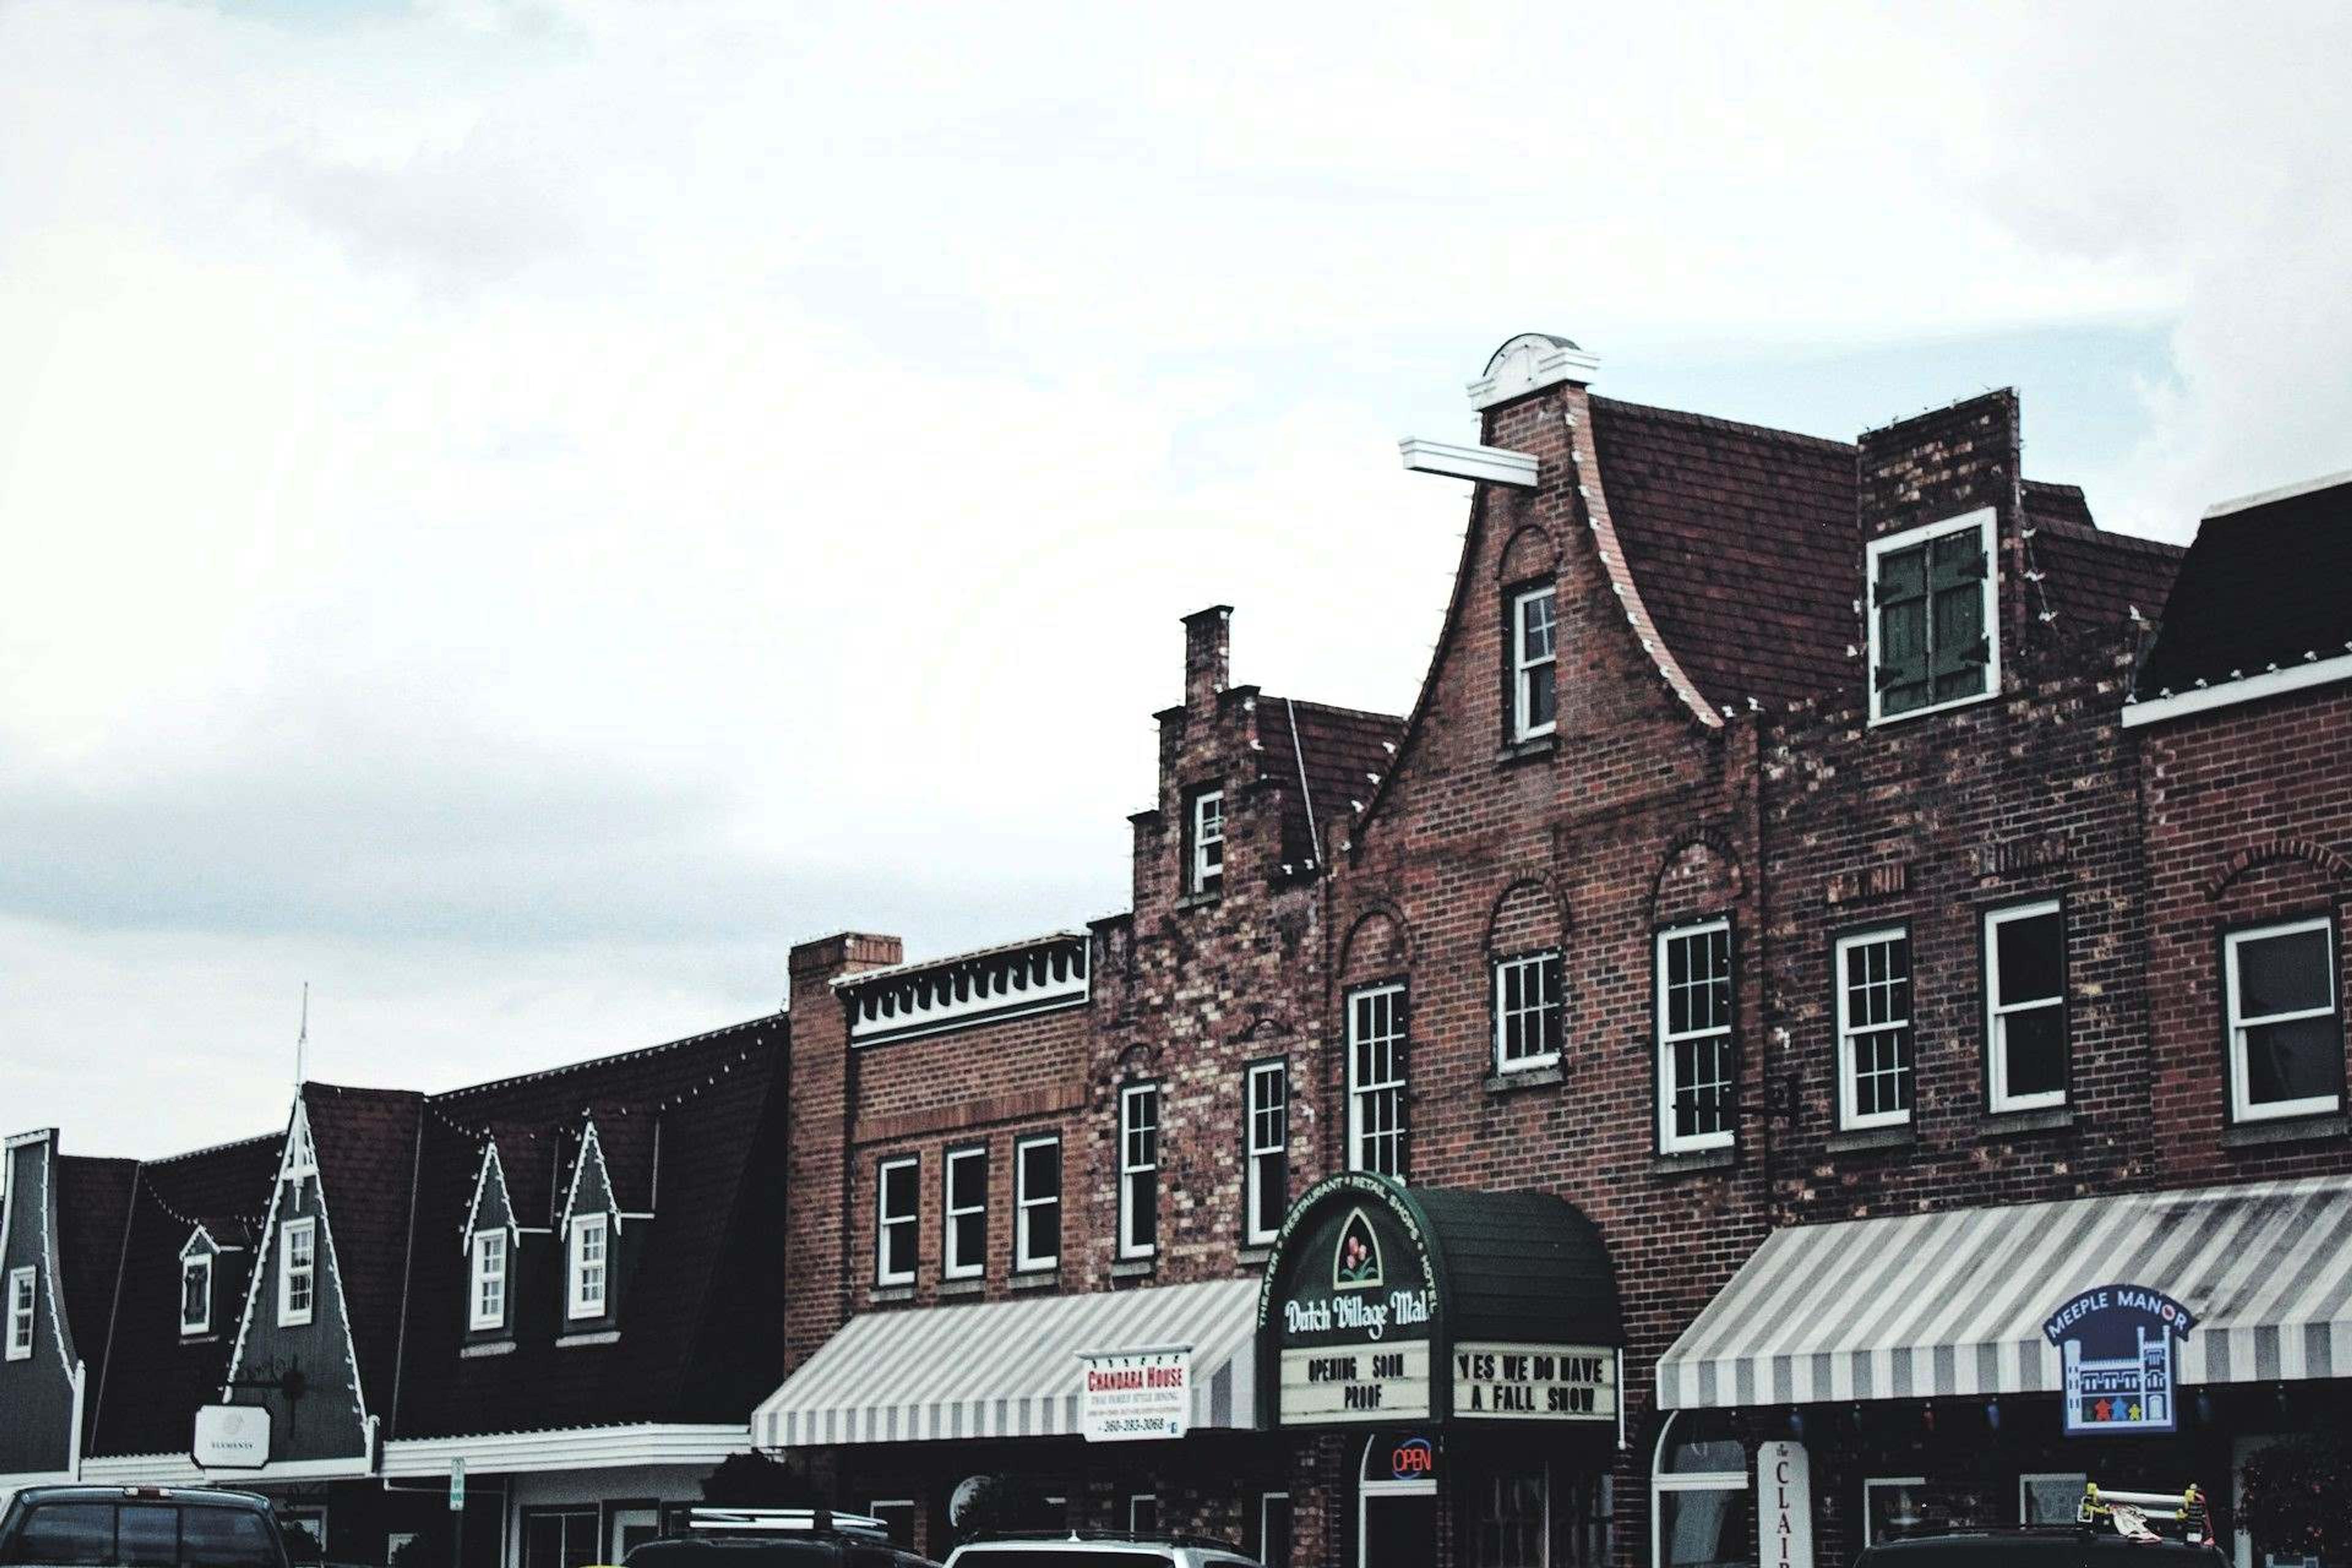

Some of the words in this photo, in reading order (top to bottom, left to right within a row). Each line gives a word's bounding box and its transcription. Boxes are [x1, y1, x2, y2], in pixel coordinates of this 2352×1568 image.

[1258, 1252, 1279, 1328] THEATER
[1282, 1176, 1343, 1237] RESTAURANT
[1351, 1176, 1387, 1199] RETAIL
[1389, 1194, 1420, 1241] SHOPS
[1420, 1254, 1439, 1314] HOTEL
[1284, 1299, 1331, 1333] Dutch
[1333, 1295, 1389, 1340] Village
[2048, 1292, 2109, 1338] MEEPLE
[2117, 1291, 2187, 1331] MANOR
[1147, 1366, 1183, 1388] HOUSE
[1308, 1357, 1357, 1382] OPENING
[1372, 1353, 1404, 1379] SOON
[1457, 1354, 1495, 1379] YES
[1502, 1355, 1528, 1381] WE
[1534, 1355, 1555, 1381] DO
[1560, 1355, 1603, 1383] HAVE
[1344, 1384, 1382, 1409] PROOF
[1472, 1385, 1482, 1409] A
[1493, 1385, 1536, 1411] FALL
[1548, 1386, 1595, 1412] SHOW
[1392, 1449, 1431, 1471] OPEN
[1776, 1461, 1791, 1568] CLAI
